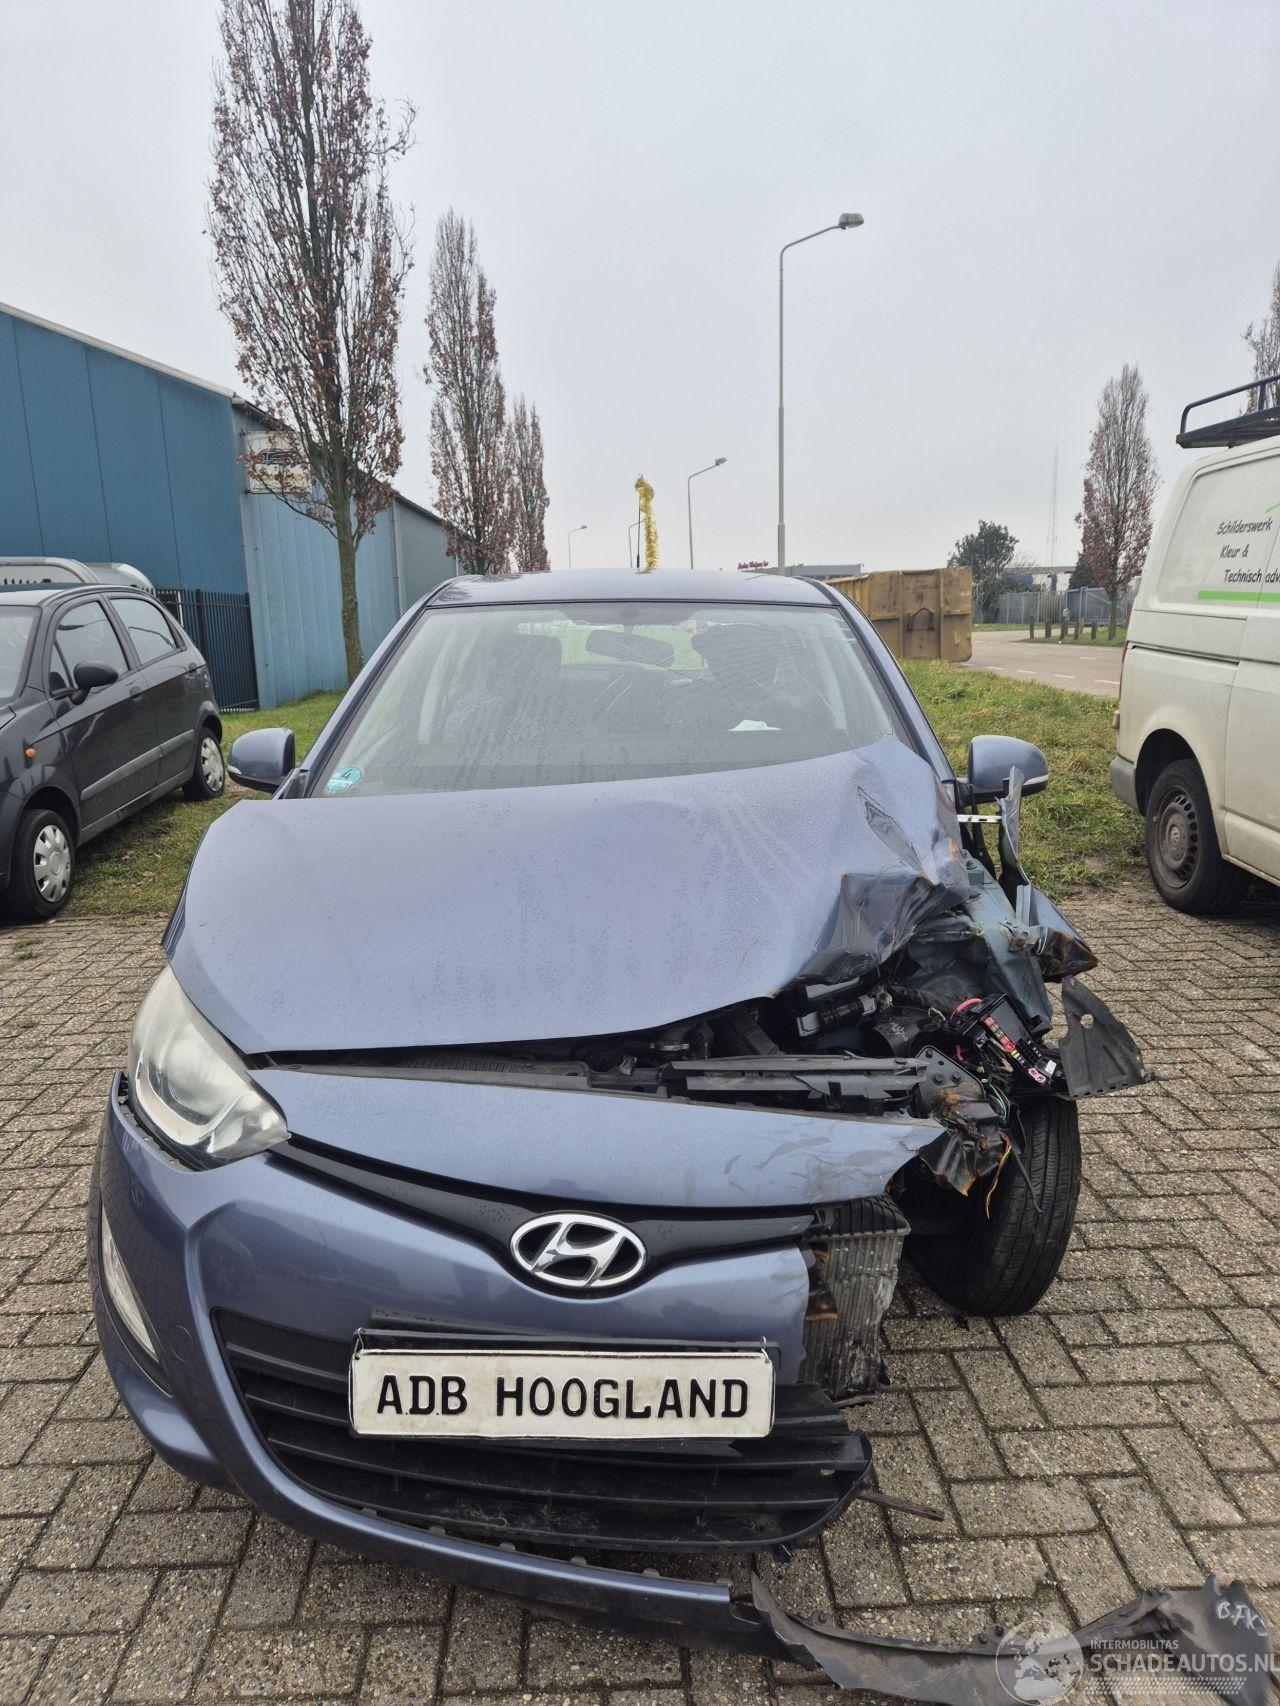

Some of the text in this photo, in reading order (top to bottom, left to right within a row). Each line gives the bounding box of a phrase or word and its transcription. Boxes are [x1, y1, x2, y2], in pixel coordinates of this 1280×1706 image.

[1216, 517, 1273, 535] Schilderswerk
[1219, 544, 1250, 559] Kleur &
[1224, 568, 1280, 583] Technisch adv
[376, 1374, 749, 1419] ADB HOOGLAND
